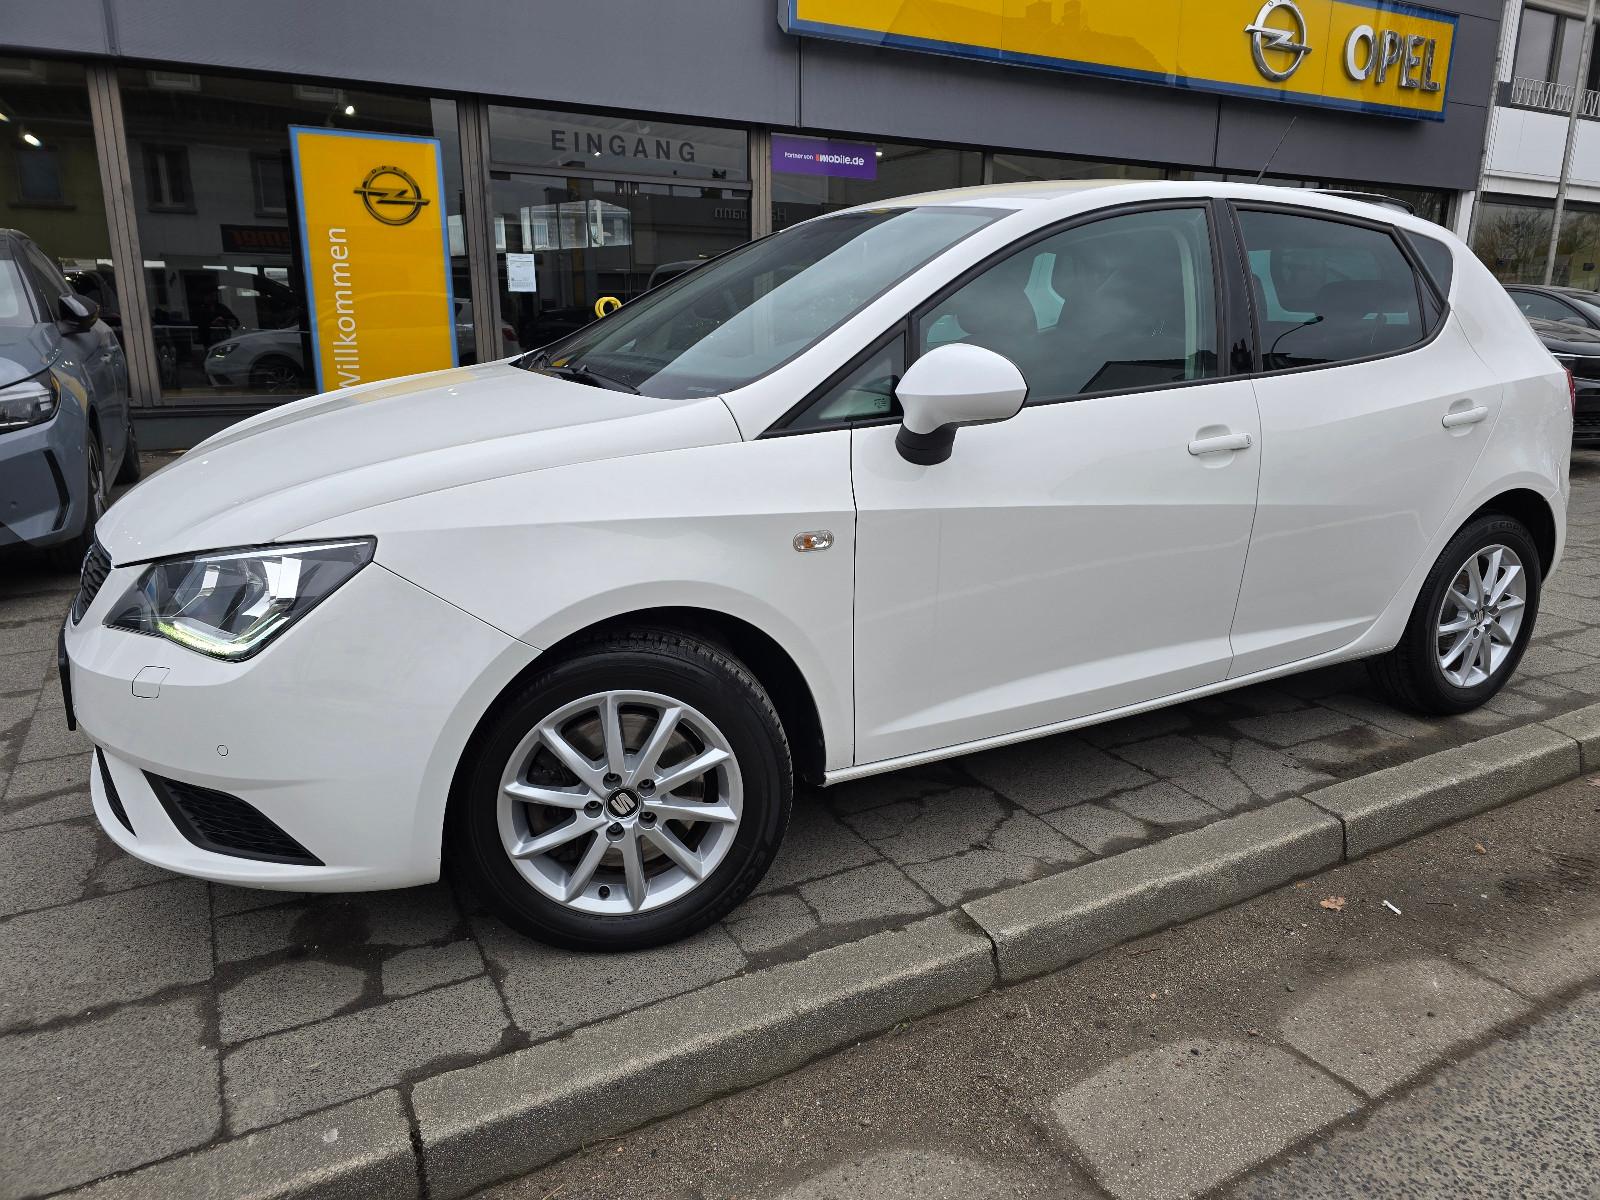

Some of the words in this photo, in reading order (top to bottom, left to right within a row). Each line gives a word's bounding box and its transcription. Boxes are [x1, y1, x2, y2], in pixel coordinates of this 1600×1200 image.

[1344, 24, 1440, 92] OPEL
[551, 129, 696, 163] EINGANG
[784, 151, 804, 160] Partner
